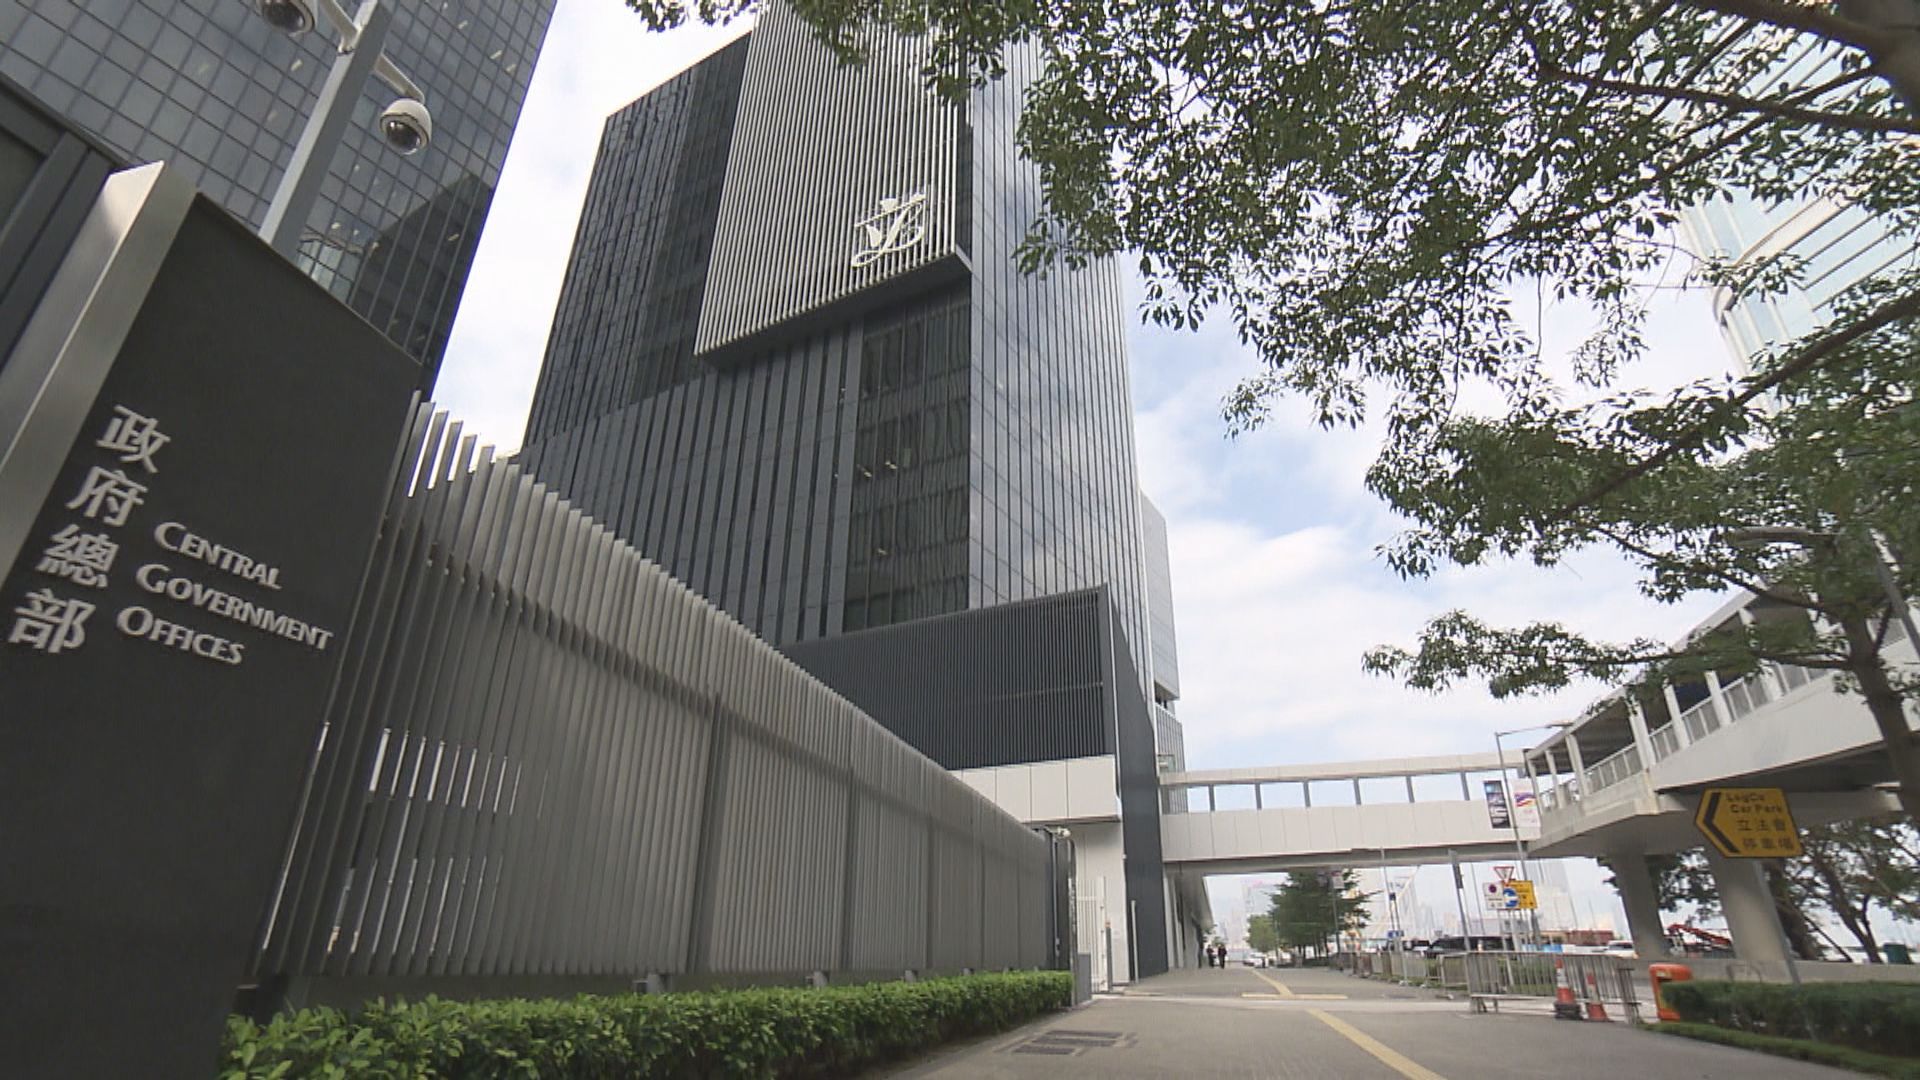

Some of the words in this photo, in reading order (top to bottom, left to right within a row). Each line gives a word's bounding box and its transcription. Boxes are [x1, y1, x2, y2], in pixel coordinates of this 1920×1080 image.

[9, 404, 171, 653] 政府總部
[154, 522, 281, 590] CENTRAL
[117, 606, 244, 664] OFFICES
[136, 564, 334, 650] GOVERNMENT
